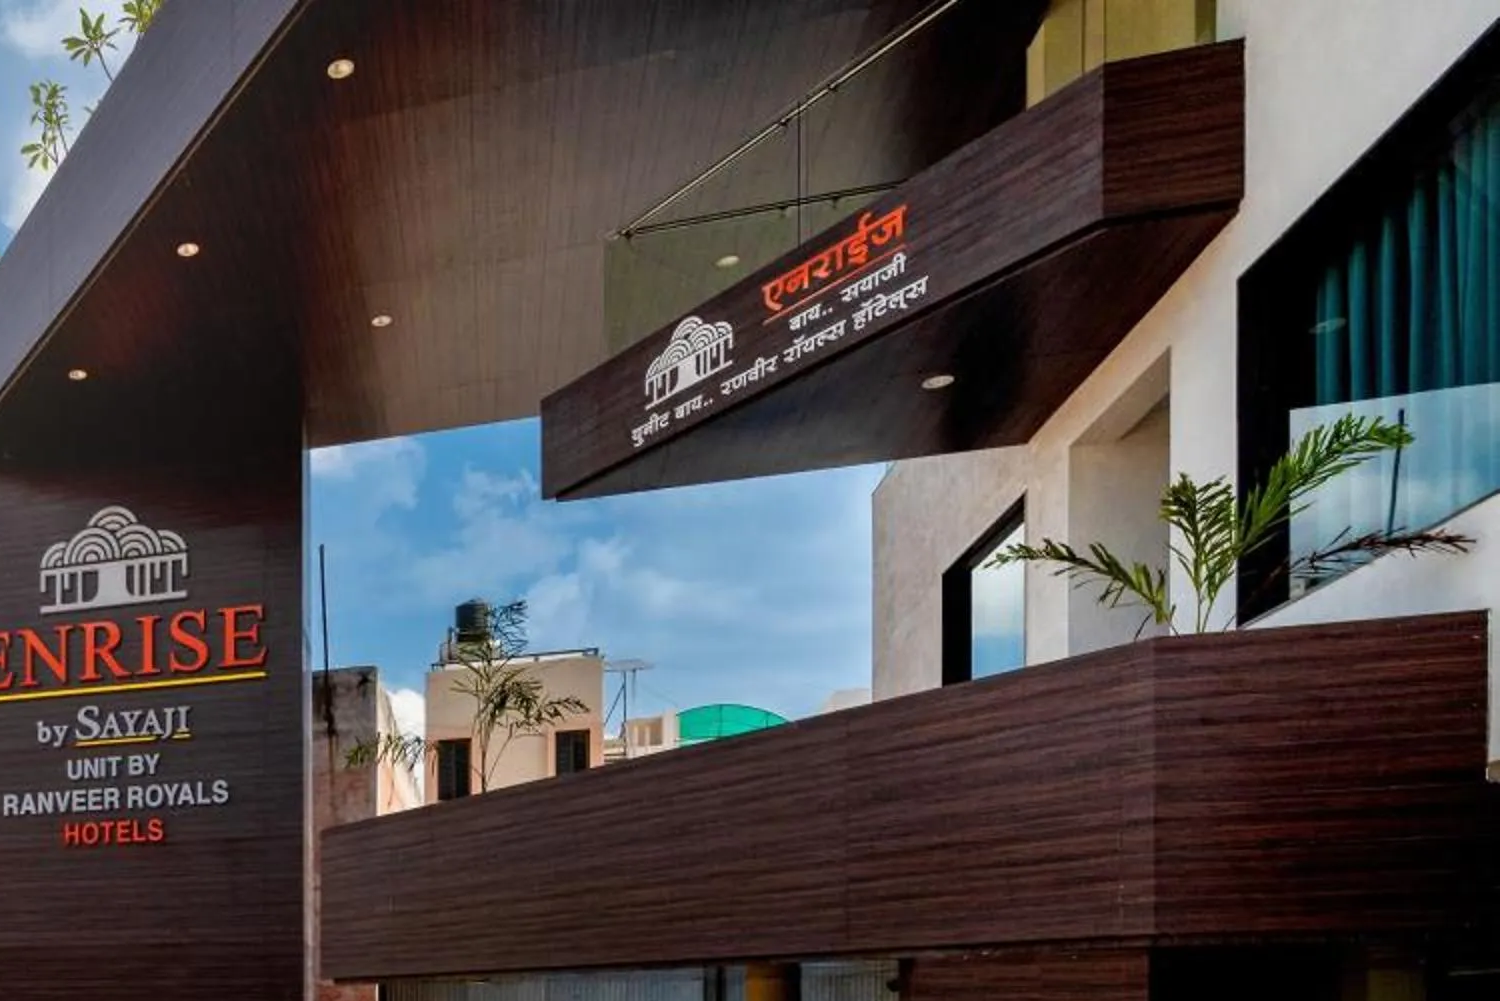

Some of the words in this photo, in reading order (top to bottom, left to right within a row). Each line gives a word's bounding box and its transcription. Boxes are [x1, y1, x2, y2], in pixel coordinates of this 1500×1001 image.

[762, 204, 907, 311] एनराईज
[840, 252, 907, 302] सयाजी
[720, 355, 778, 395] रणवीर
[783, 320, 846, 363] रॉयल्स
[36, 720, 68, 747] by
[75, 705, 191, 740] SAYAJI
[67, 756, 122, 780] UNIT
[128, 754, 160, 776] BY
[3, 786, 120, 817] RANVEER
[127, 780, 229, 809] ROYALS
[62, 820, 165, 846] HOTELS
